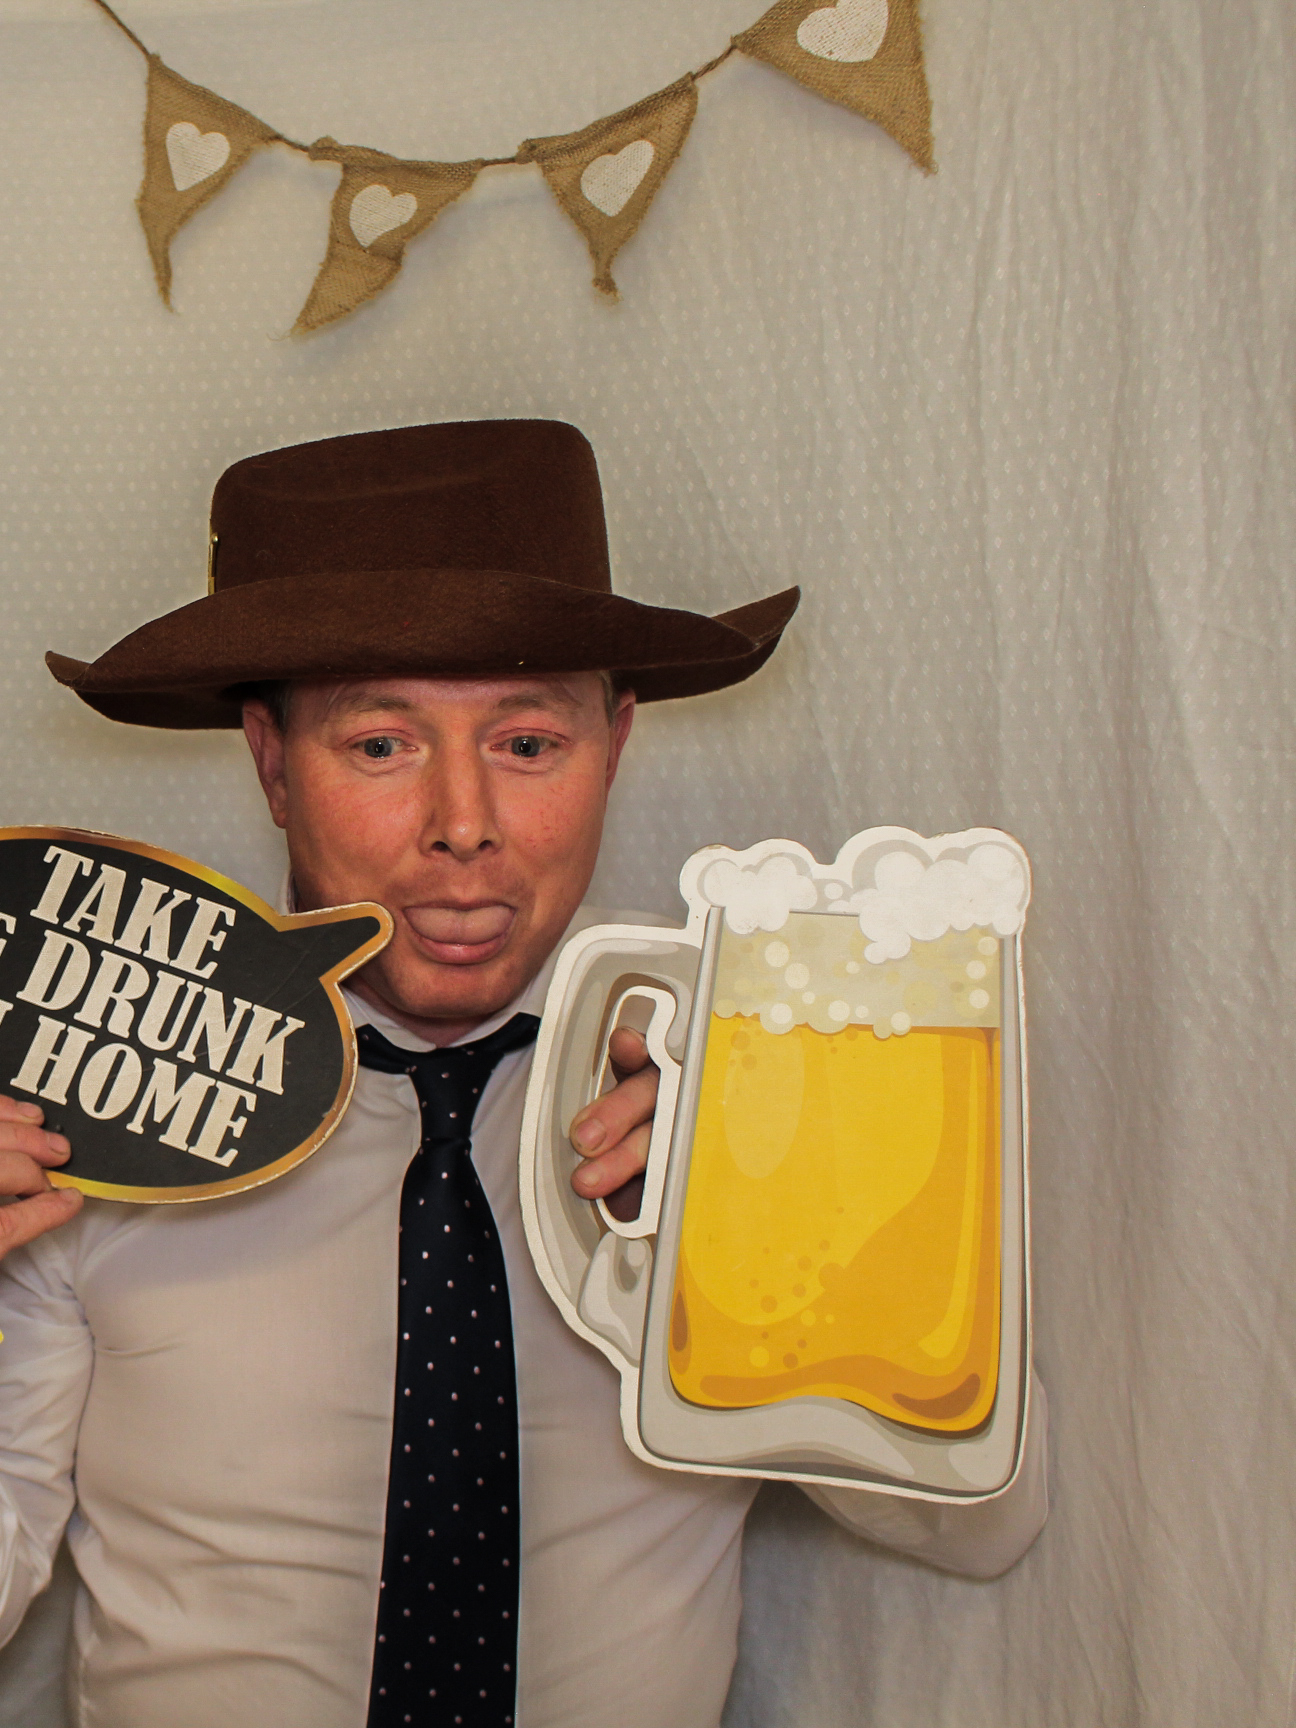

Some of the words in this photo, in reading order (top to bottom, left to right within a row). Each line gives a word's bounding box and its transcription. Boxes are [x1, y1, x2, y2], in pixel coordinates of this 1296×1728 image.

[30, 845, 237, 980] TAKE
[16, 929, 305, 1095] DRUNK
[10, 1015, 256, 1168] HOME
